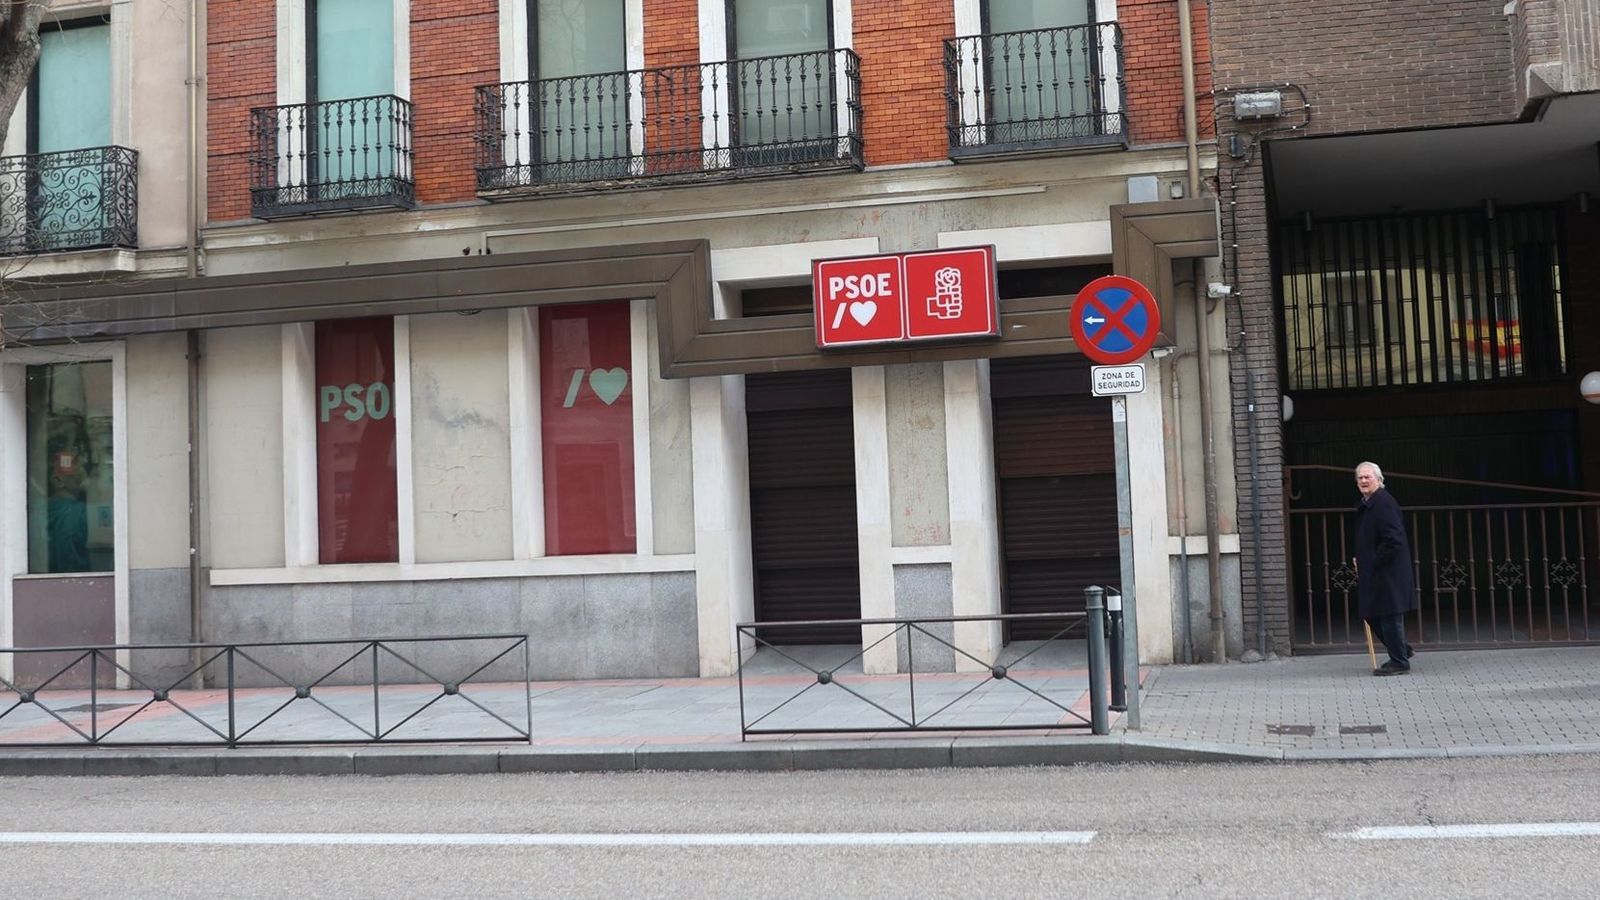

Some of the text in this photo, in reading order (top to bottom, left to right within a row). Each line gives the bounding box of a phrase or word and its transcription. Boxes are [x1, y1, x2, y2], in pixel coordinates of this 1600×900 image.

[829, 273, 892, 300] PSOE
[1098, 380, 1140, 389] SEGURIDAD
[1101, 371, 1135, 380] ZONA DE
[320, 382, 395, 422] PSO
